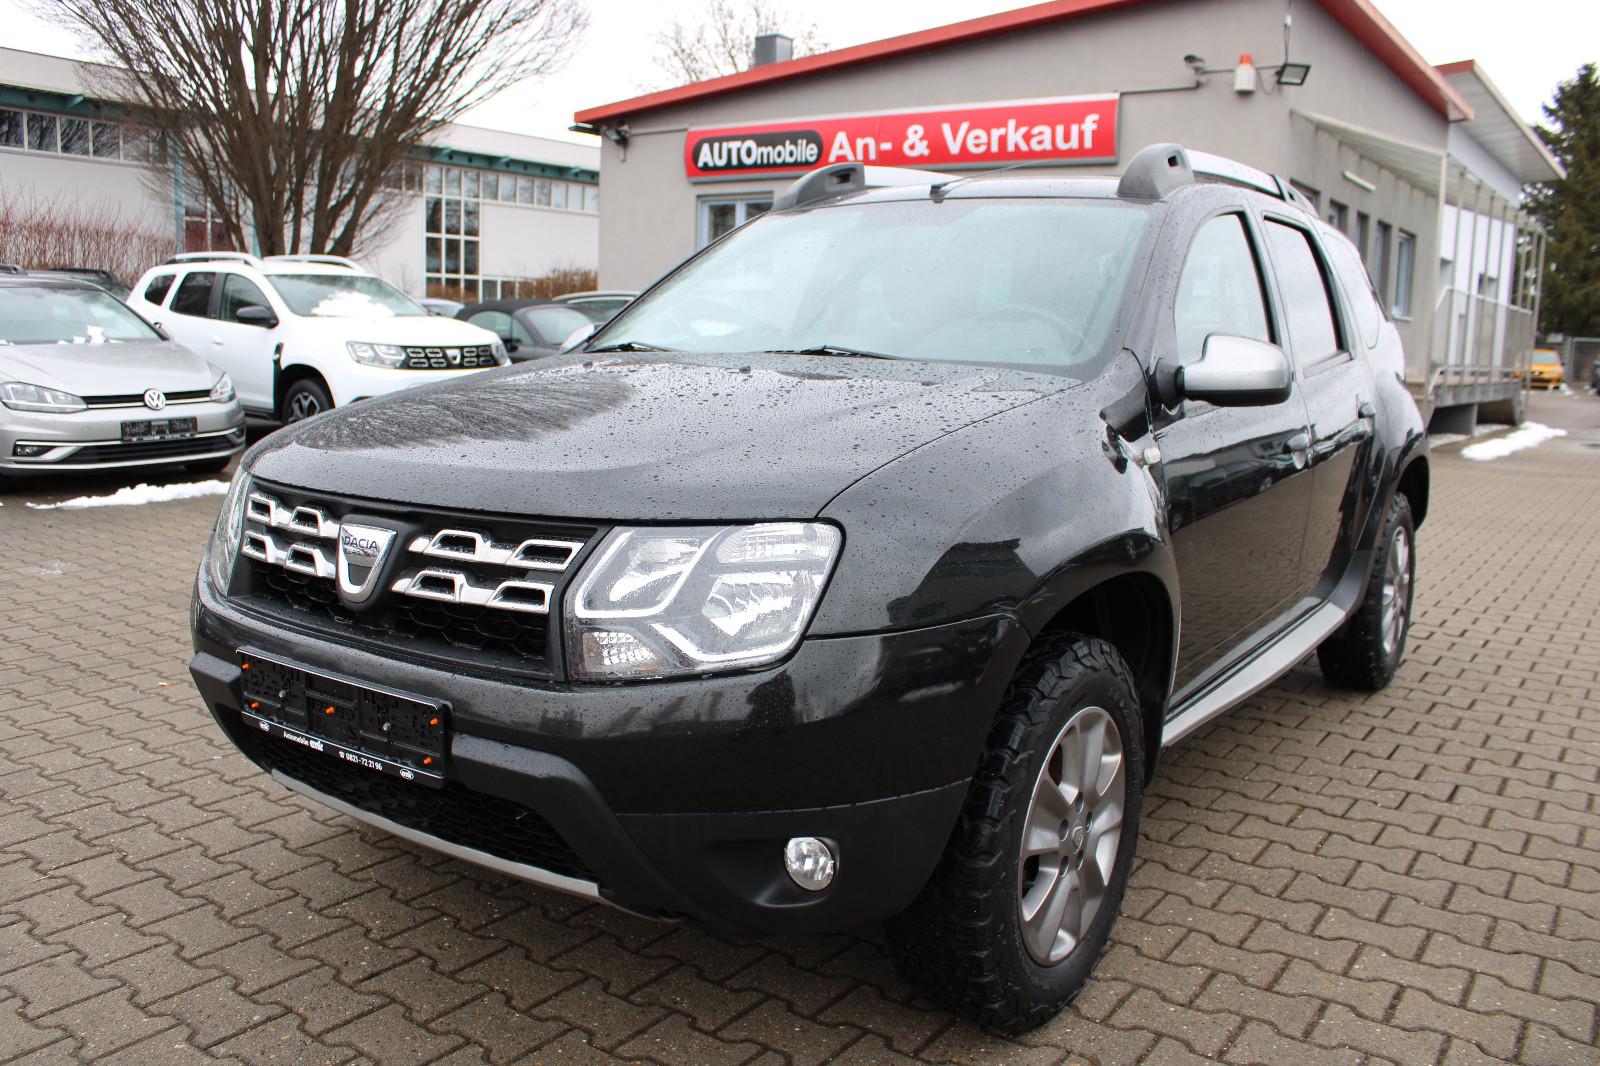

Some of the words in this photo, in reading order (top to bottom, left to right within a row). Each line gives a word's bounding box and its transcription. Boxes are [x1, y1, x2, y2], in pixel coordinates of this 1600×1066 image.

[697, 139, 818, 168] AUTOmobile
[827, 131, 893, 162] An-
[902, 124, 930, 157] &
[941, 113, 1100, 155] Verkauf
[343, 535, 378, 550] DACIA
